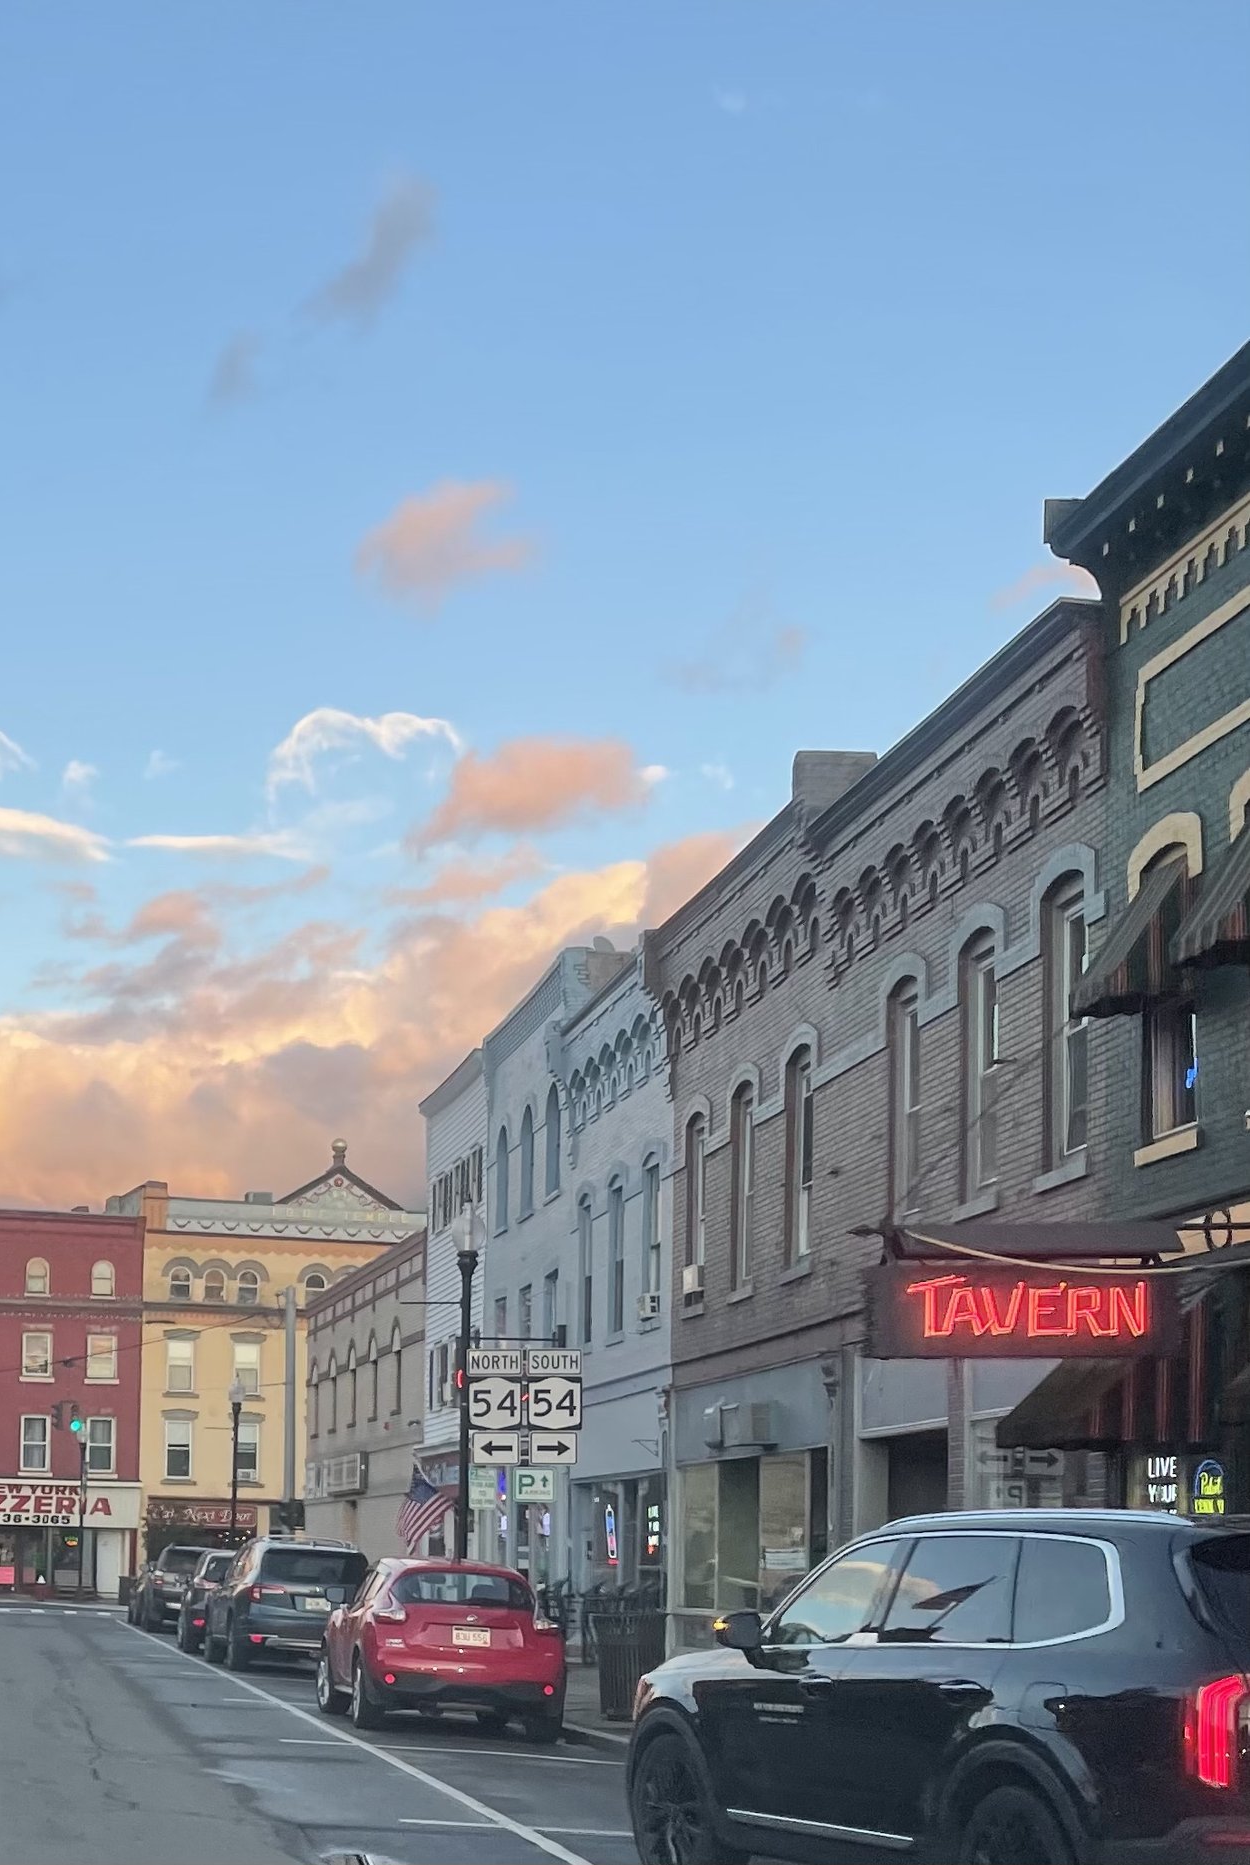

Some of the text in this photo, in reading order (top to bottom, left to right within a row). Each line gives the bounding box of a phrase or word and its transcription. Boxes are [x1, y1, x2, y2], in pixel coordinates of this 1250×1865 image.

[907, 1275, 1146, 1337] TAVERN
[471, 1354, 518, 1369] NORTH
[531, 1354, 578, 1369] SOUTH
[473, 1389, 517, 1417] 54
[533, 1389, 576, 1417] 54
[1148, 1456, 1177, 1478] LIVE
[30, 1485, 80, 1496] YORK
